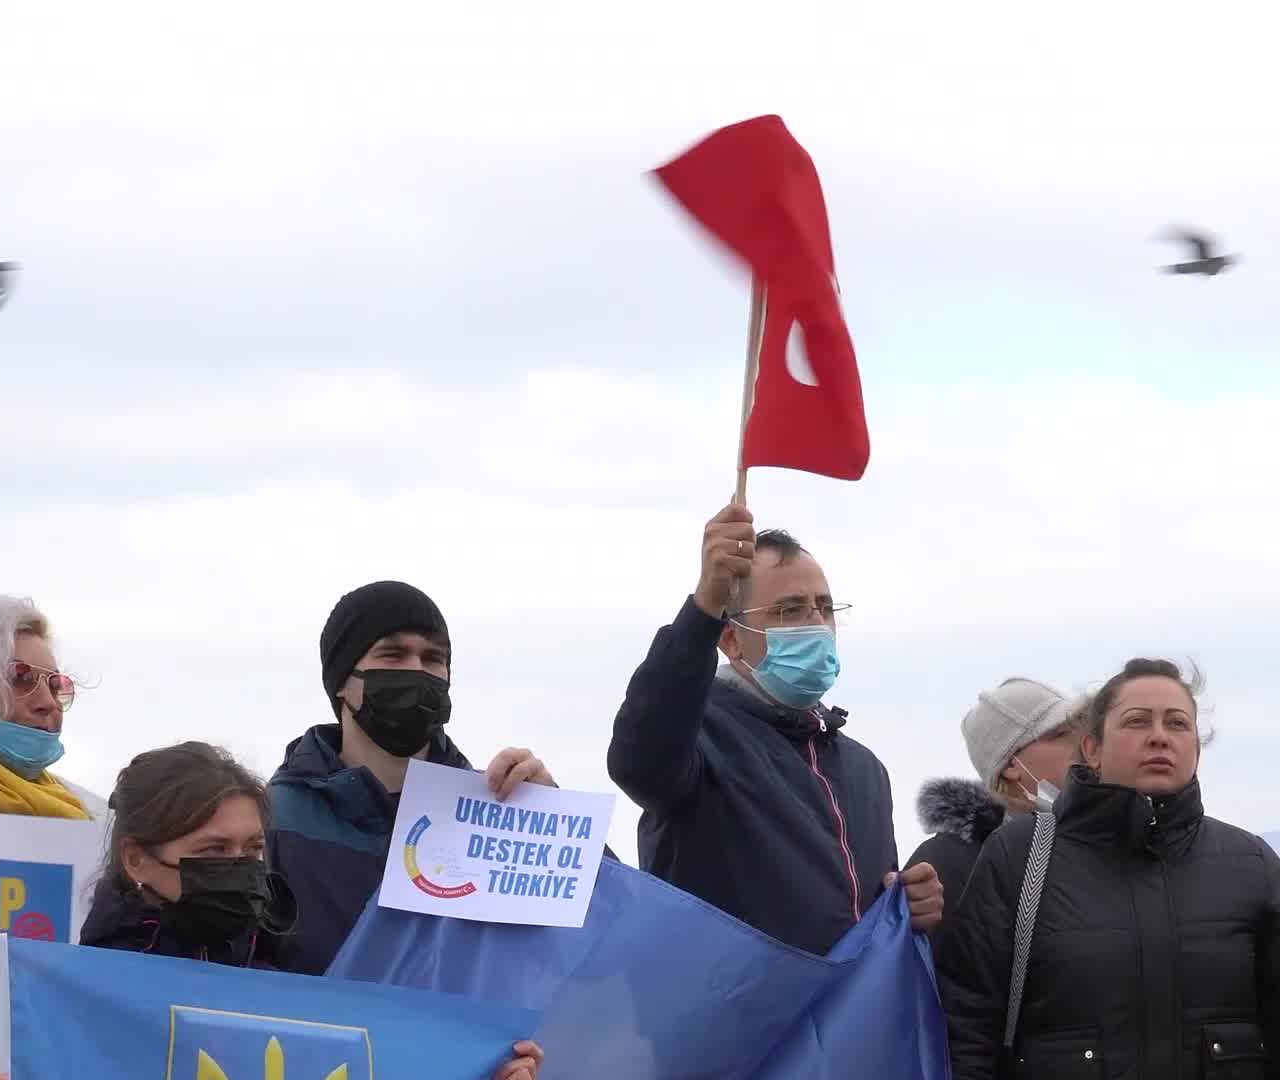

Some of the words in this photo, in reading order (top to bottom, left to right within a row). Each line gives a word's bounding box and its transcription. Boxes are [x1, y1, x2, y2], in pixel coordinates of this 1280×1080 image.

[456, 797, 593, 839] UKRAYNA'YA
[467, 834, 552, 867] DESTEK
[557, 845, 583, 870] OL
[488, 865, 578, 899] TÜRKİYE
